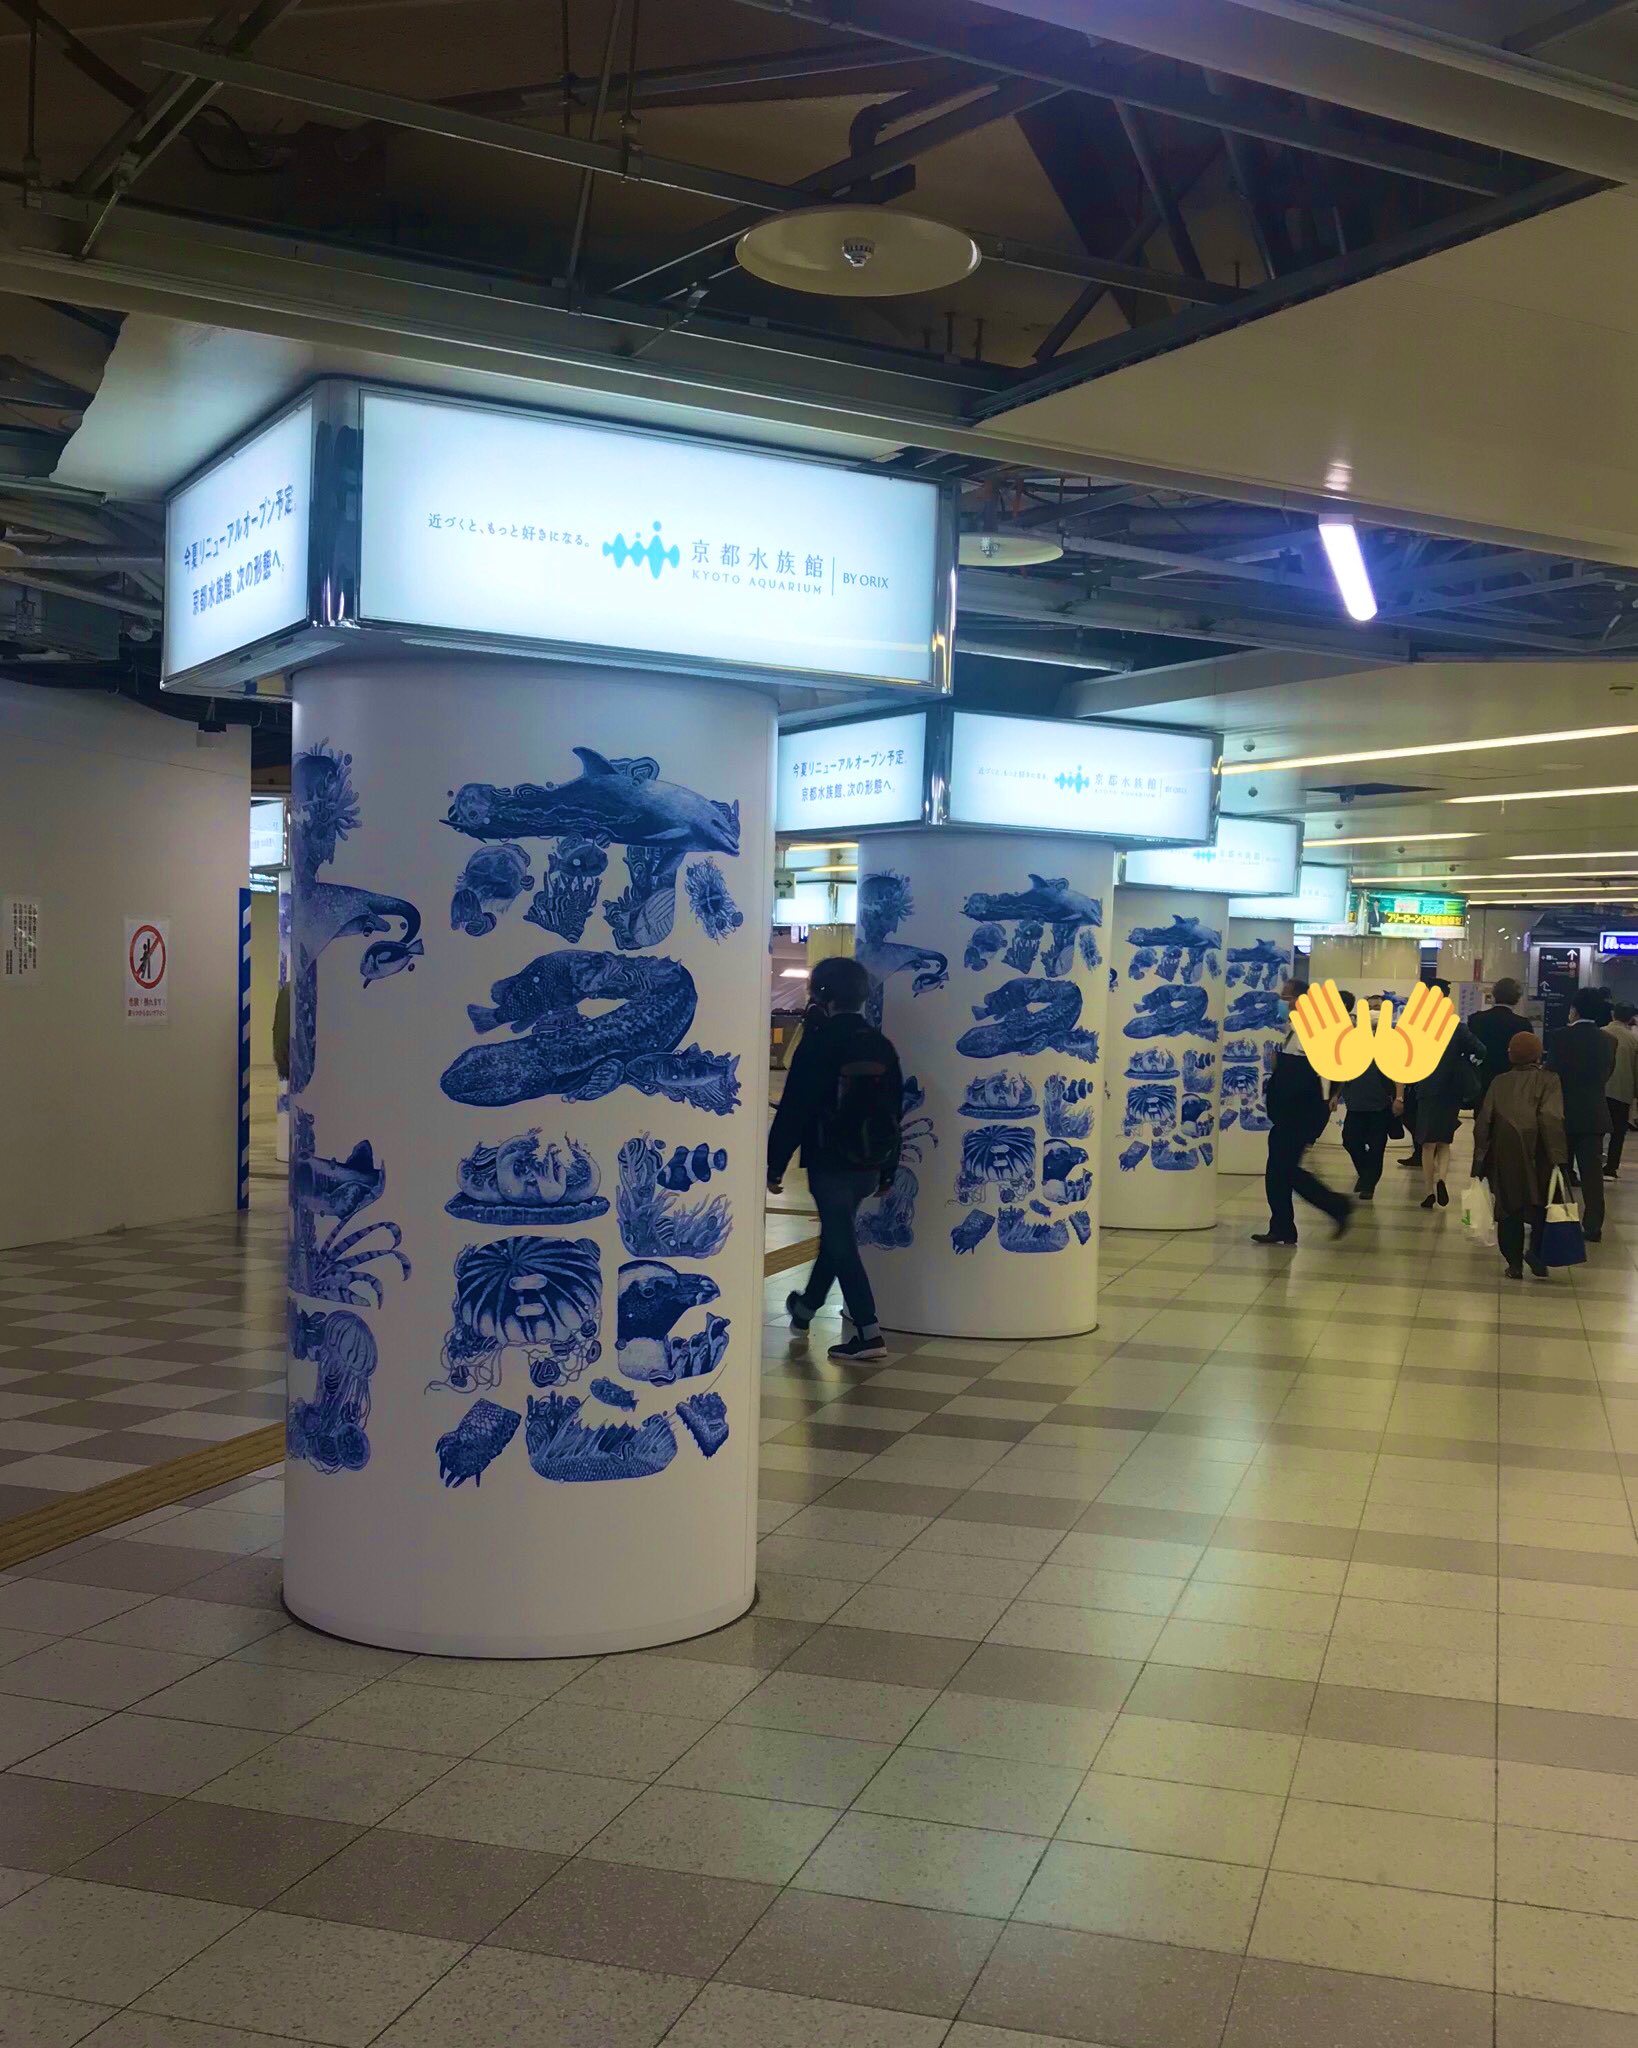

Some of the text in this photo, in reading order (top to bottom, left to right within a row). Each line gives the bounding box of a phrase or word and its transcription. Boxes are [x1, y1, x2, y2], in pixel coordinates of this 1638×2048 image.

[428, 513, 590, 548] 近づくと、もっと好きになる。
[691, 539, 824, 579] 京都水族館
[692, 569, 822, 595] KYOTO AQUARIUM
[842, 572, 889, 589] BY ORIX
